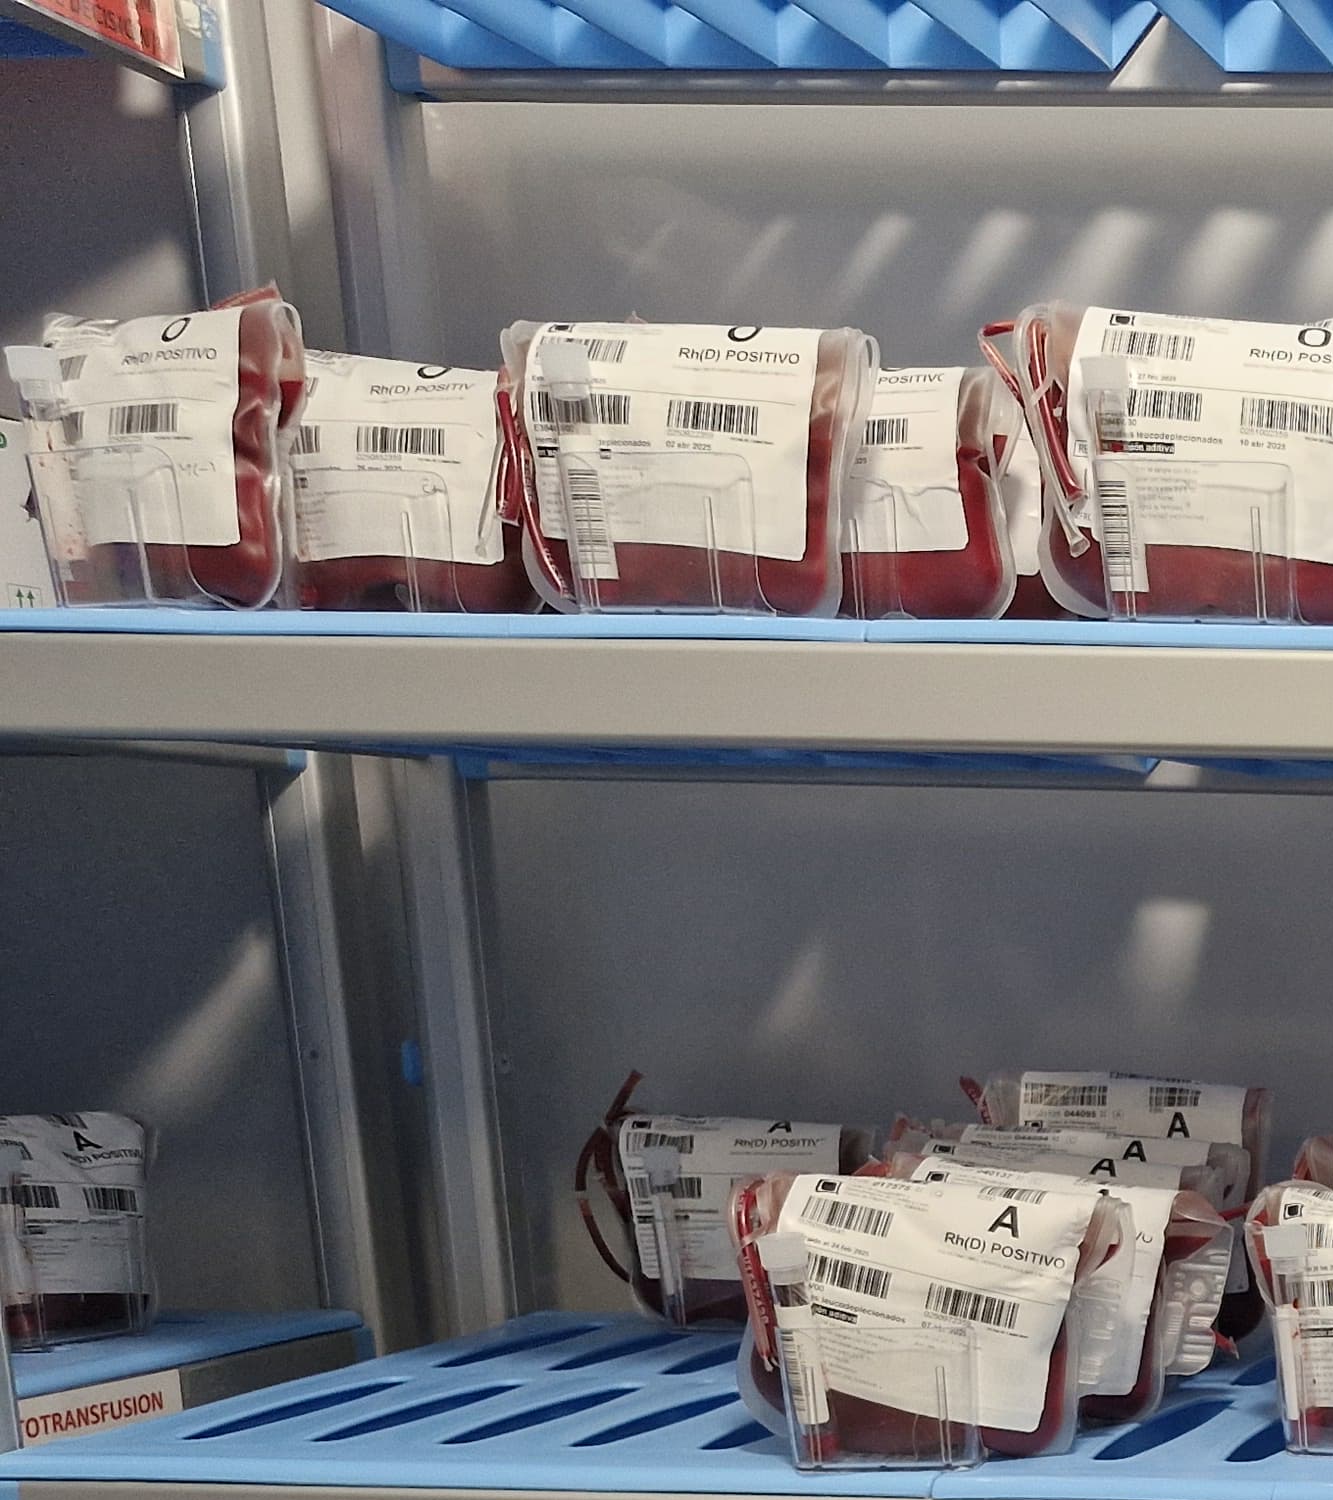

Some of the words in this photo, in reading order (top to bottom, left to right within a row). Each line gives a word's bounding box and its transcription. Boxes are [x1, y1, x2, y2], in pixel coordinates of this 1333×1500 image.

[1298, 327, 1331, 348] O
[155, 347, 217, 362] POSITIVO
[679, 347, 721, 363] Rh(D)
[725, 348, 801, 365] POSITIVO
[1249, 347, 1294, 364] Rh(D)
[369, 382, 411, 396] Rh(D)
[1166, 1112, 1190, 1138] A
[1122, 1140, 1147, 1162] A
[987, 1206, 1020, 1238] A
[943, 1231, 987, 1255] Rh(D)
[991, 1242, 1066, 1270] POSITIVO
